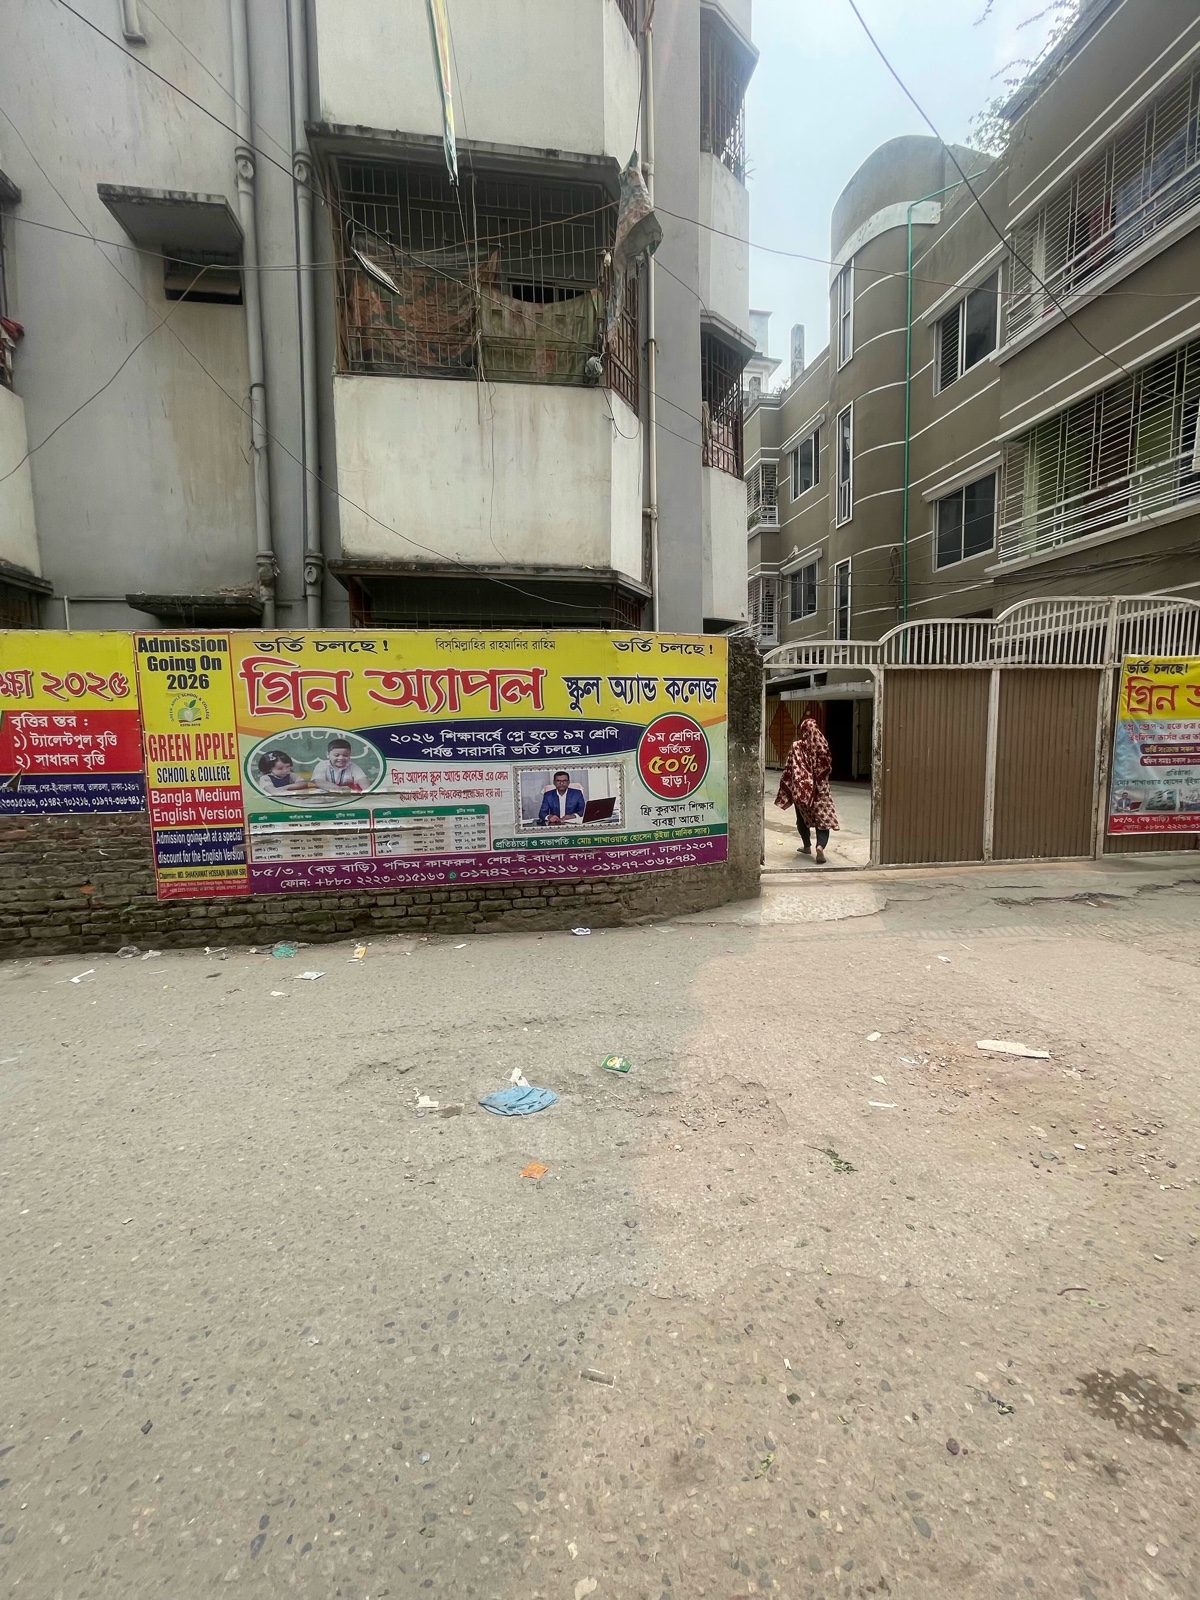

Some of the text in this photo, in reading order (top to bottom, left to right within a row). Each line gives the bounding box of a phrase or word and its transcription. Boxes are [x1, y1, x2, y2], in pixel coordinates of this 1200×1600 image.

[138, 636, 228, 653] Admission
[252, 636, 306, 654] ভর্তি
[531, 638, 556, 651] রাহিম
[611, 637, 654, 653] ভর্তি
[147, 655, 222, 673] Going On
[1126, 659, 1189, 676] ভর্তি চলছে!
[41, 670, 130, 702] ২০২৫
[166, 673, 210, 690] 2026
[238, 655, 547, 721] গ্রিন অ্যাপল
[560, 673, 720, 715] স্কুল অ্যান্ড কলেজ
[1125, 675, 1180, 715] গ্রিন
[9, 711, 49, 733] বৃত্তির
[13, 730, 118, 751] ১) ট্যালেন্টপুল বৃত্তি
[389, 726, 620, 745] ২০২৬ শিক্ষাবর্ষে প্লে হতে ৯ম শ্রেণি
[646, 728, 702, 743] ৯ম শ্রেণির
[148, 732, 236, 762] GREEN APPLE
[421, 743, 453, 758] পর্যন্ত
[456, 743, 507, 757] সরাসরি
[510, 742, 541, 756] ভর্তি
[658, 743, 692, 755] ভর্তিতে
[15, 750, 106, 770] ২) সাধারন বৃত্তি
[648, 753, 699, 775] ৫০%
[157, 766, 231, 783] SCHOOL & COLLEGE
[391, 768, 509, 787] গ্রিন অ্যাপল স্কুল অ্যান্ড কলেজ এর কোন
[660, 775, 688, 788] ছাড়!
[151, 788, 241, 806] Bangla Medium
[438, 786, 462, 800] শিক্ষকের
[152, 807, 196, 825] English
[199, 805, 242, 820] Version
[640, 800, 715, 817] ফ্রি কুরআন শিক্ষার
[651, 816, 677, 828] ব্যবস্থা
[156, 831, 186, 845] Admission
[186, 830, 203, 846] going
[211, 830, 218, 842] at
[218, 832, 222, 842] a
[222, 828, 243, 844] special
[495, 838, 529, 849] প্রতিষ্ঠাতা
[530, 839, 538, 847] ও
[539, 836, 570, 847] সভাপতি
[592, 834, 628, 845] শাখাওয়াত
[629, 832, 652, 843] হোসেন
[671, 827, 693, 839] (মানিক
[694, 826, 711, 836] স্যার)
[157, 851, 183, 864] discount
[182, 850, 191, 863] for
[191, 850, 201, 862] the
[201, 849, 223, 865] English
[223, 848, 245, 861] Version
[307, 864, 337, 876] (বড়
[340, 861, 378, 873] বাড়ি)
[382, 859, 421, 871] পশ্চিম
[487, 852, 566, 866] শের-ই-বাংলা
[658, 840, 714, 854] ঢাকা-১২০৭
[315, 877, 352, 887] +৮৮০
[356, 871, 446, 886] ২২২৩-৩১৫১৬৩
[592, 853, 697, 871] ০১৯৭৭-৩৬৮৭৪১
